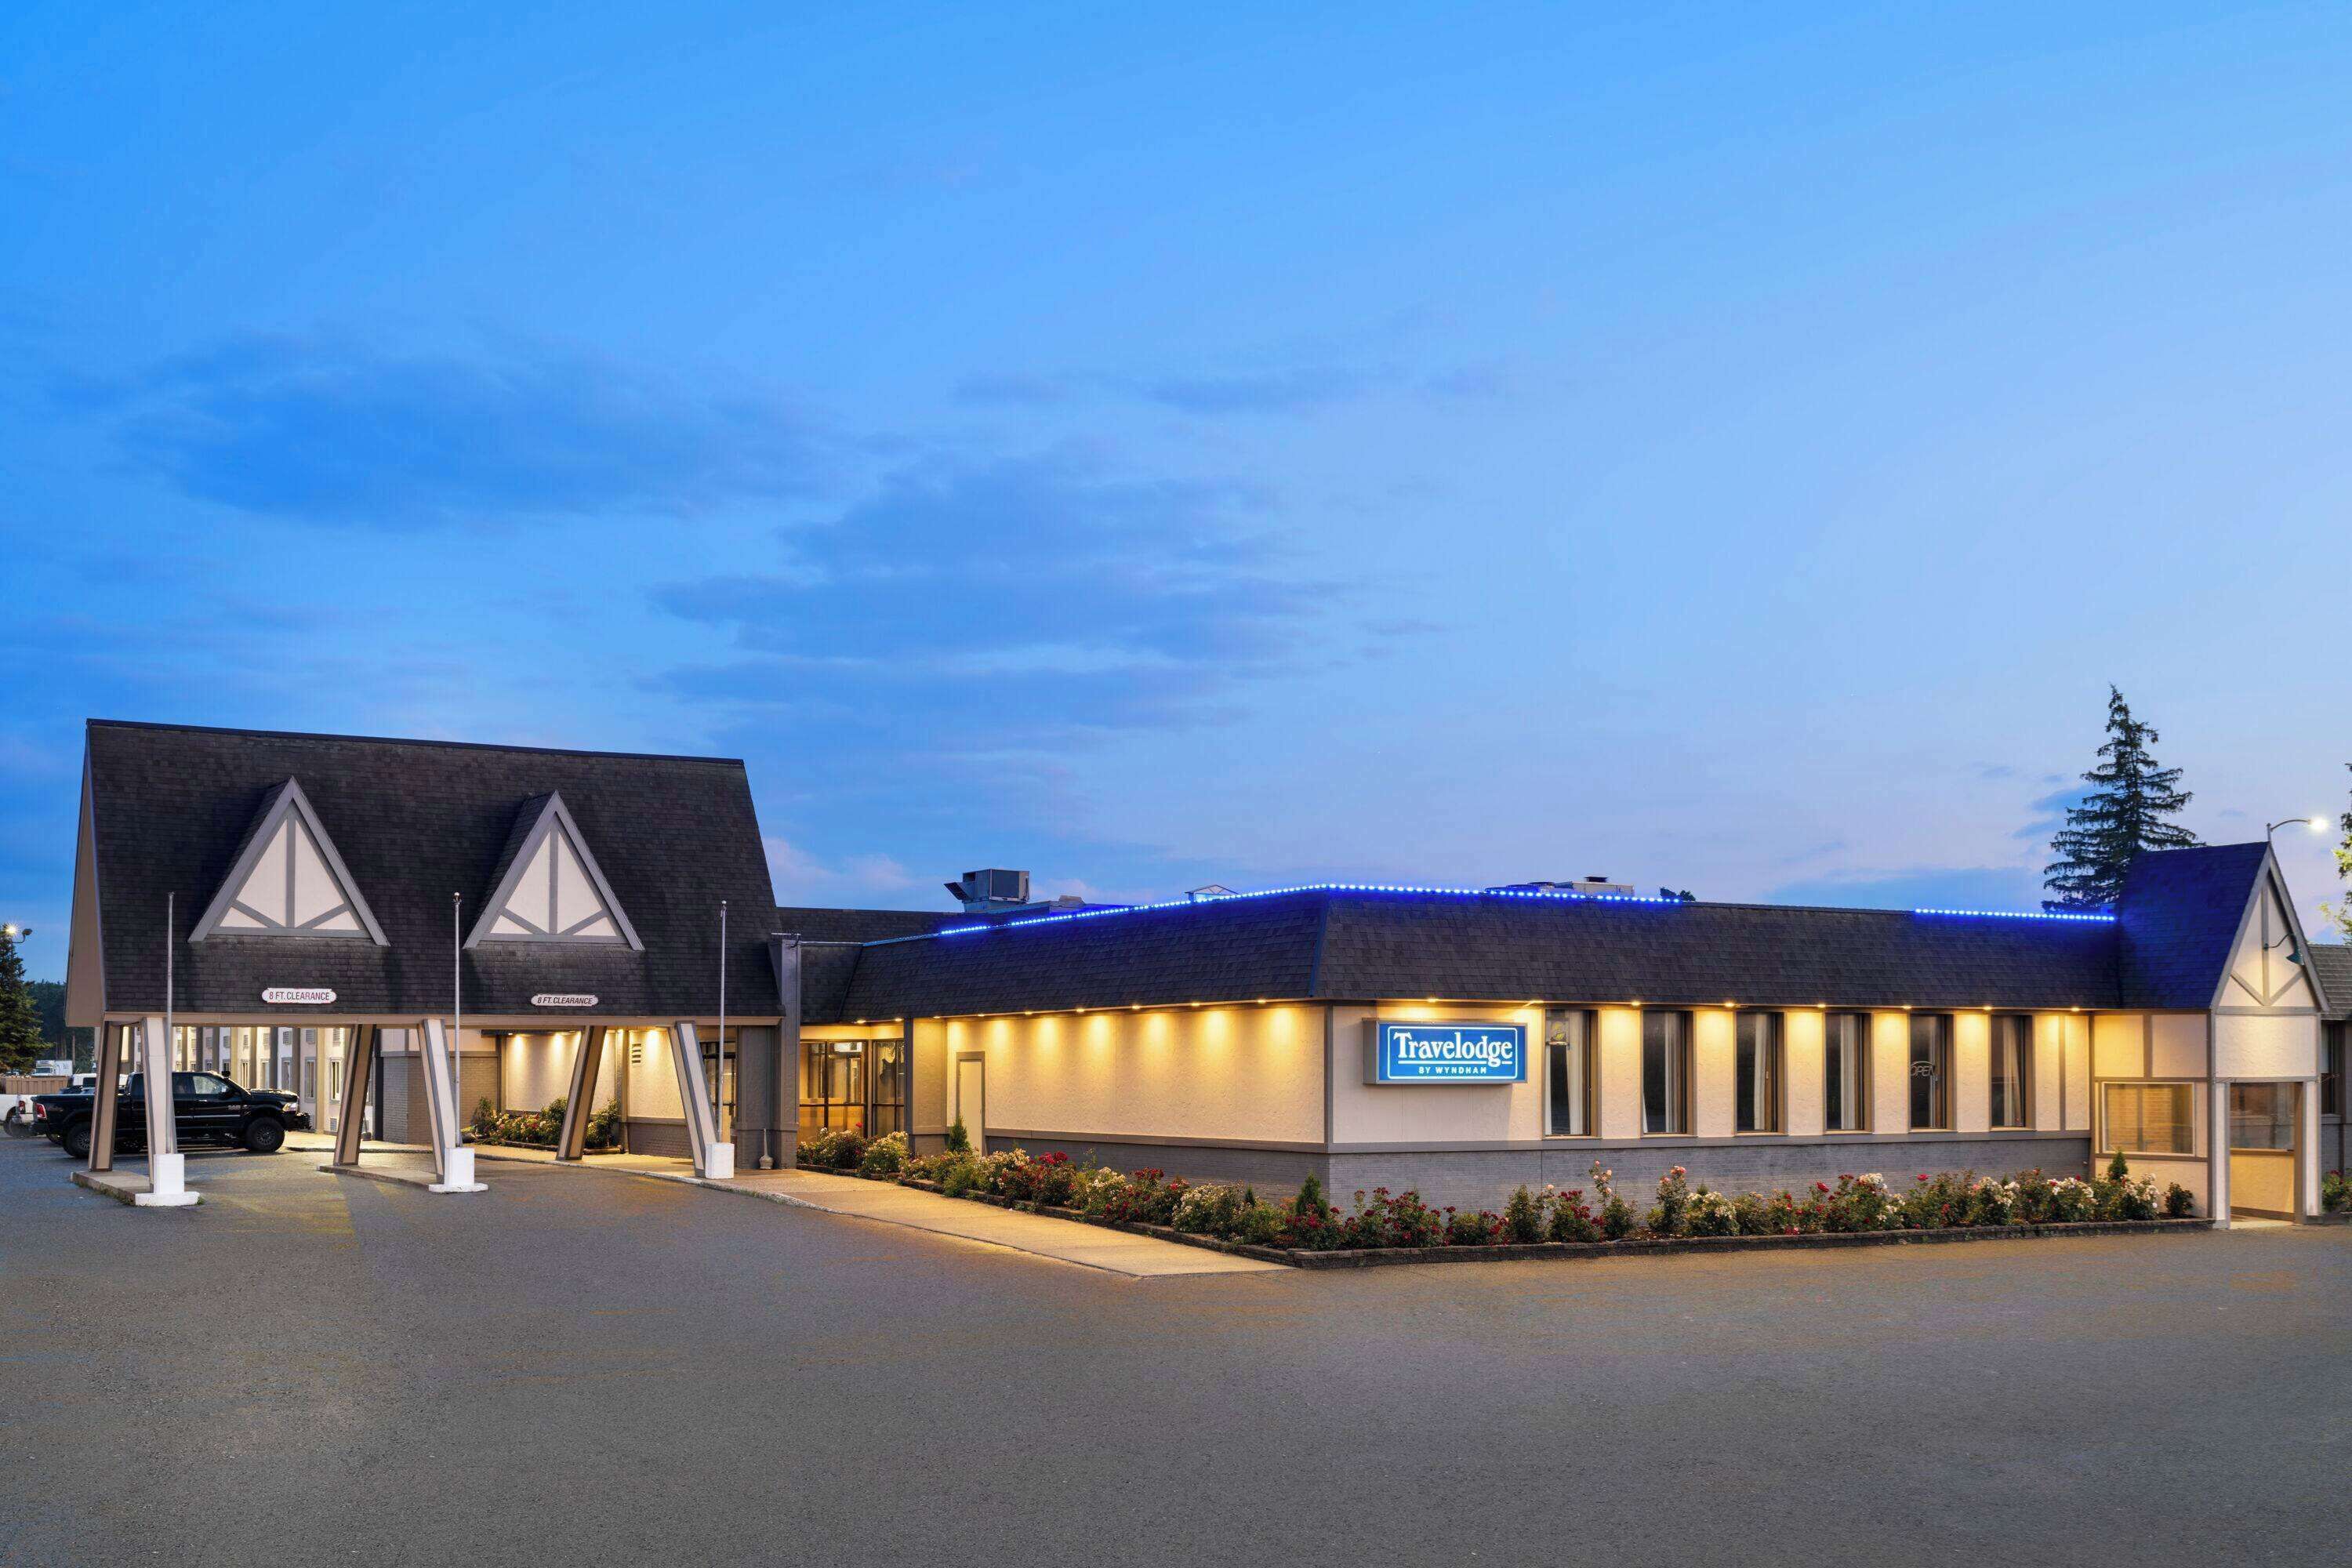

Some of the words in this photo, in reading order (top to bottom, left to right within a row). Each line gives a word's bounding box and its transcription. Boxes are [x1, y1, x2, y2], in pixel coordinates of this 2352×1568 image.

[269, 991, 274, 1000] 8
[286, 991, 330, 1000] CLEARANCE
[1393, 1032, 1513, 1067] Travelodge
